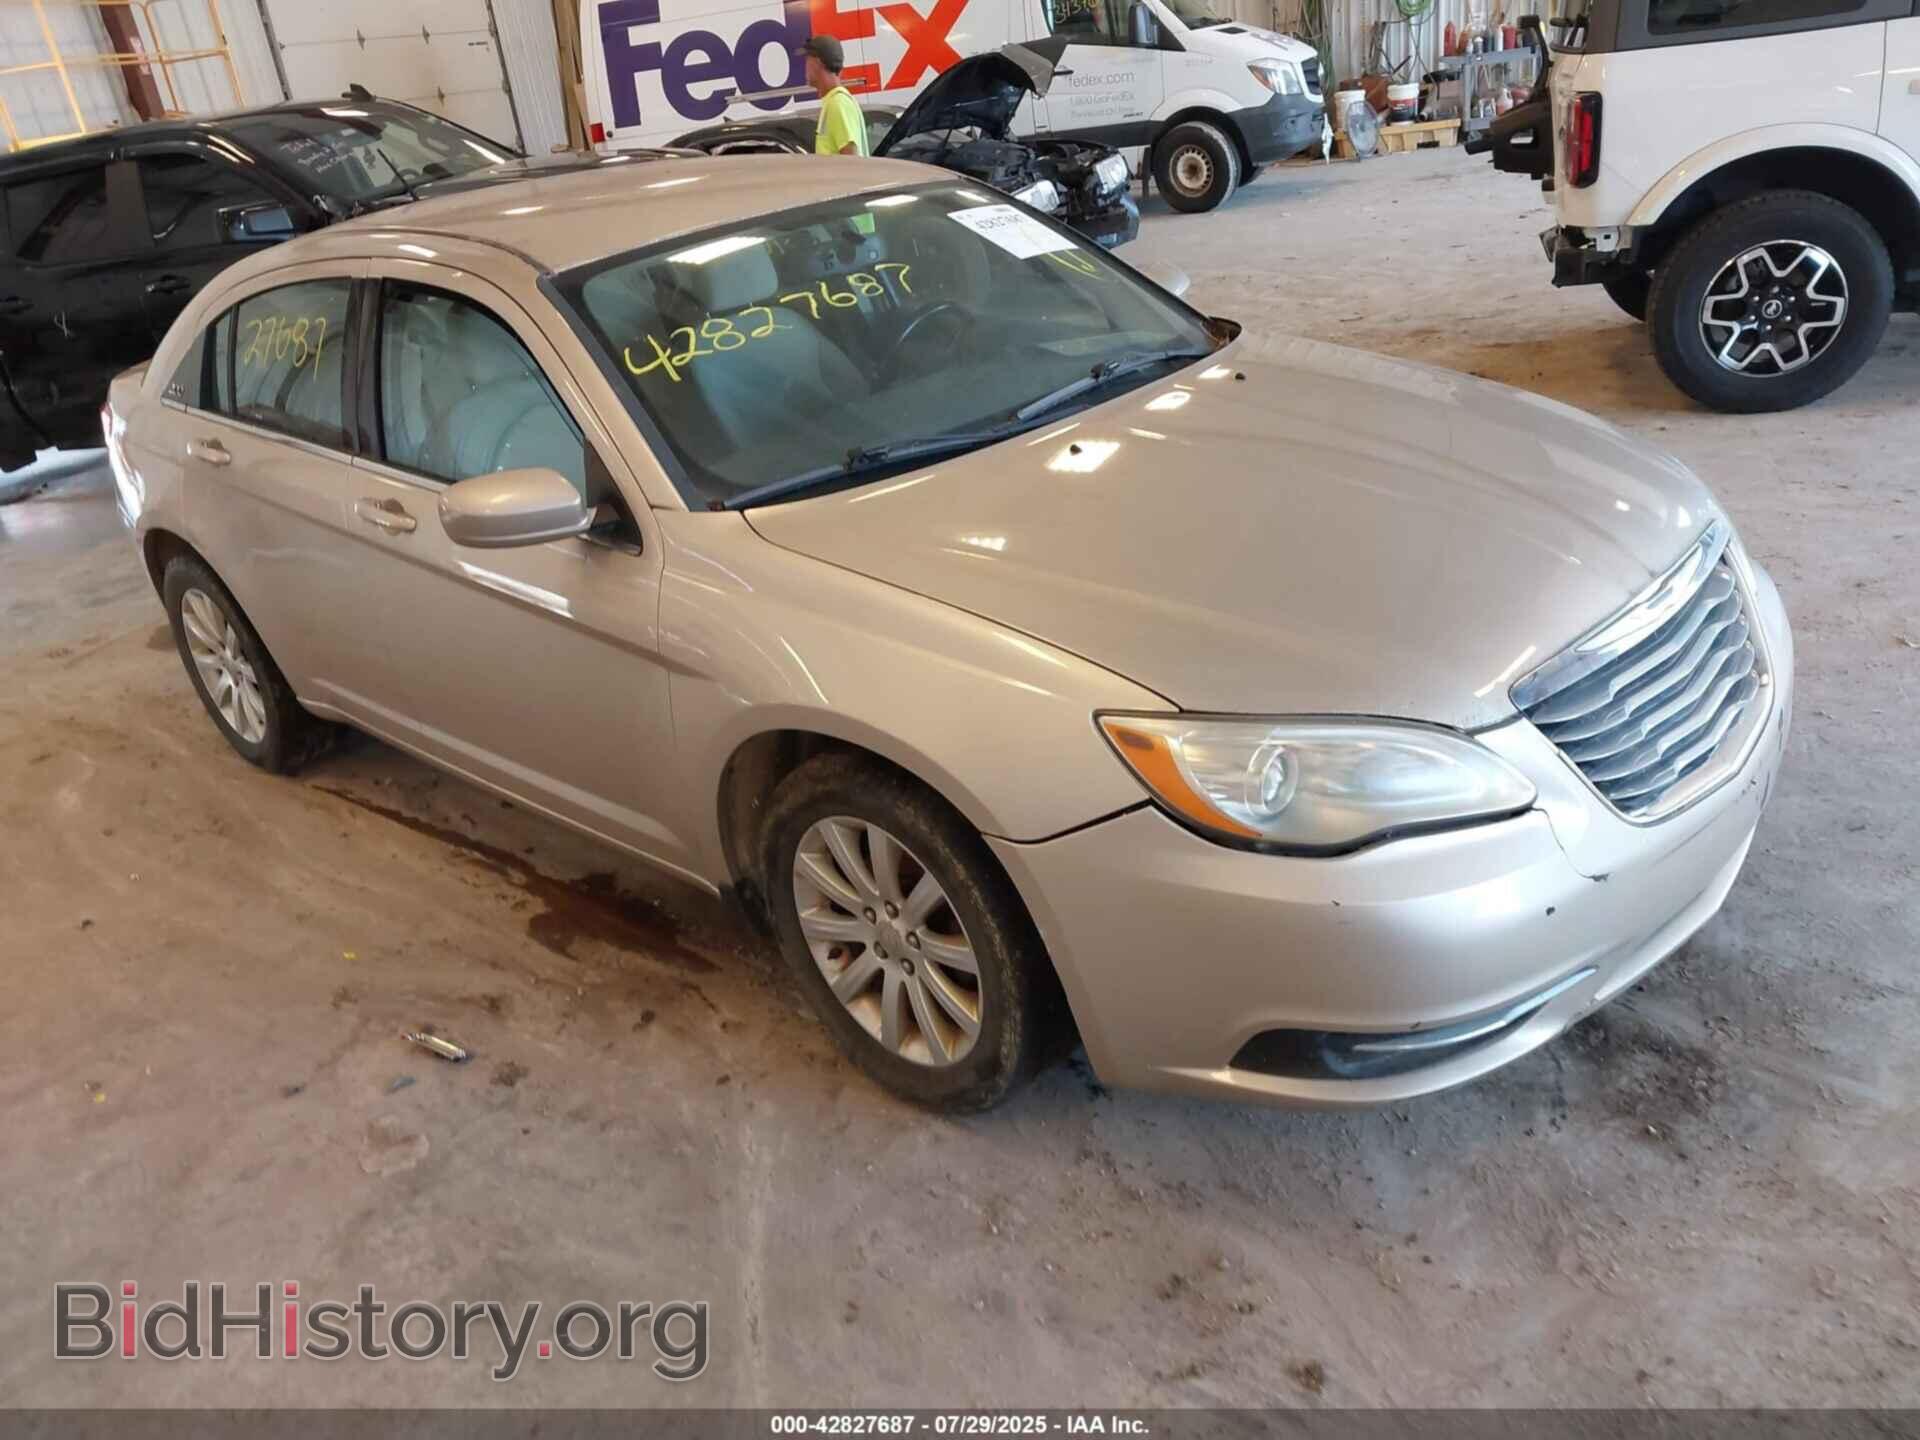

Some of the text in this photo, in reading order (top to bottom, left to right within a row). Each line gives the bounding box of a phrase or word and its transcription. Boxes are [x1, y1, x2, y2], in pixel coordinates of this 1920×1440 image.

[598, 0, 970, 128] FedEx
[1068, 71, 1135, 88] fedex.com
[244, 316, 328, 384] 27687
[624, 263, 912, 382] 42827687
